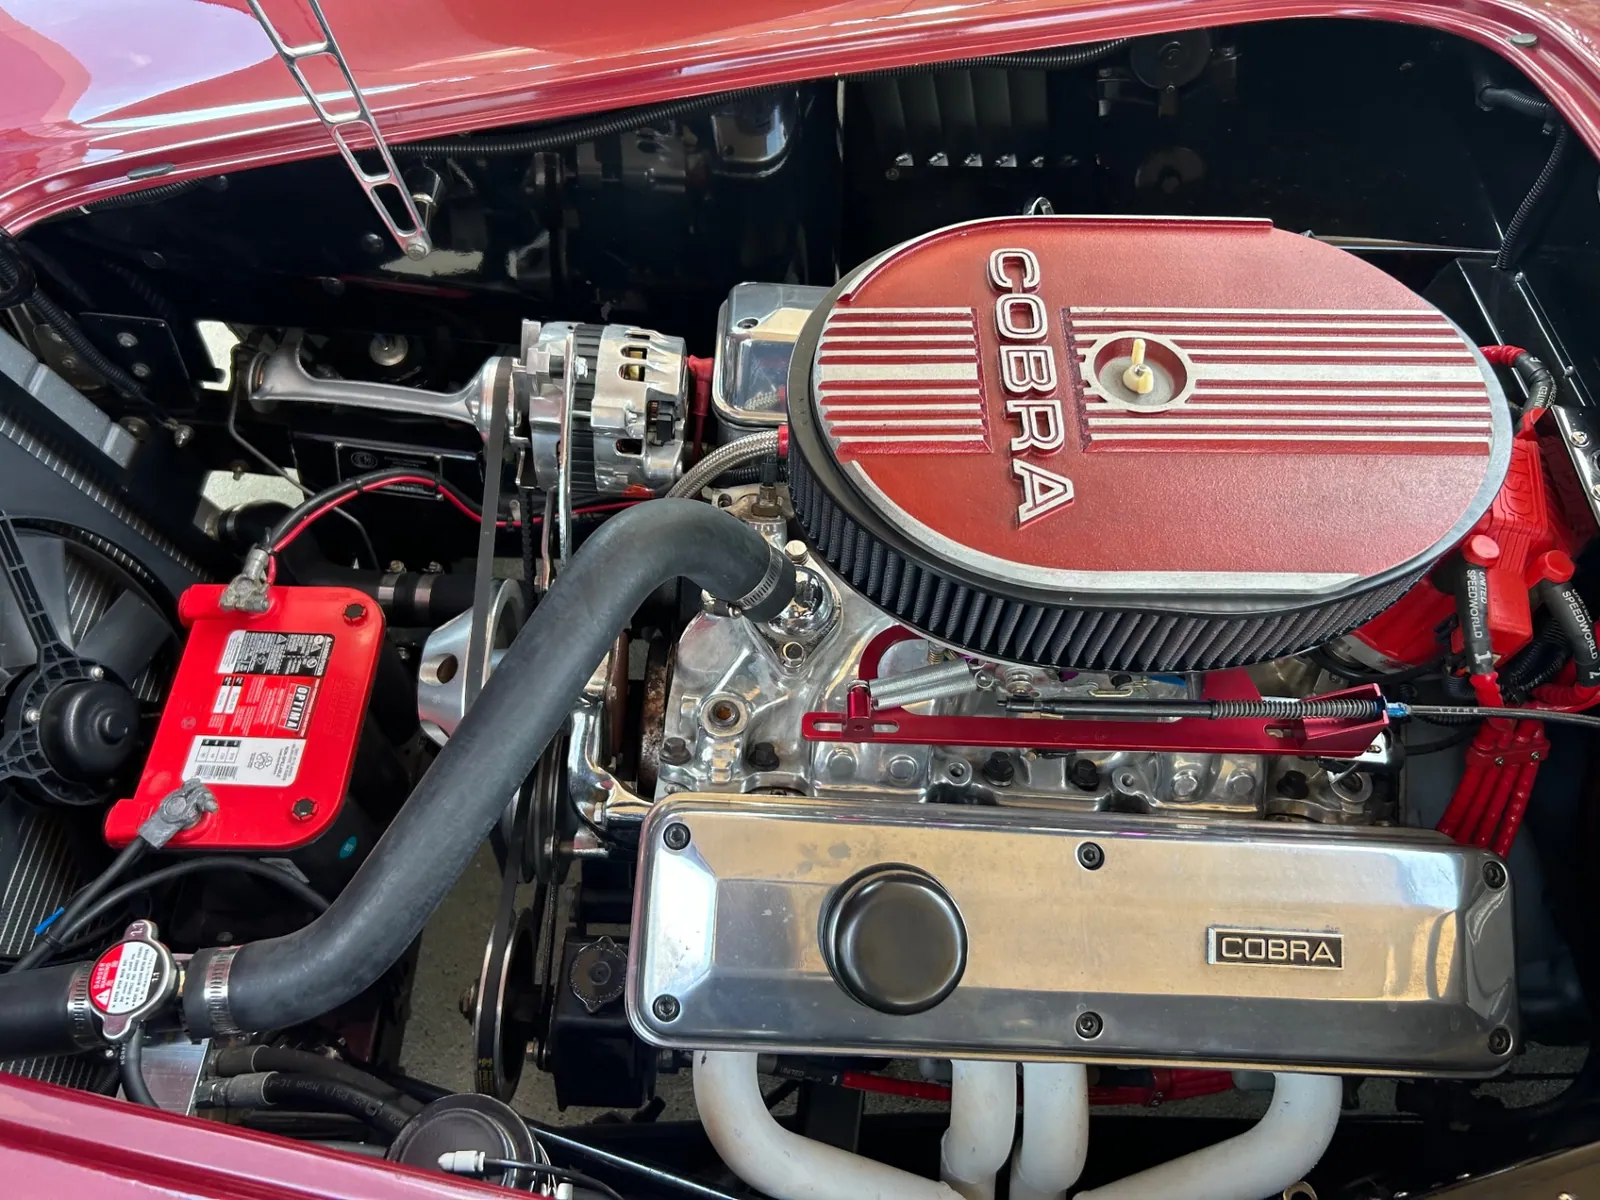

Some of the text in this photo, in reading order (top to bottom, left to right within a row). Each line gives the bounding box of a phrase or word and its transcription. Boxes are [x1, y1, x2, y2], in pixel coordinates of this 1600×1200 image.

[988, 247, 1075, 526] COBRA
[1466, 569, 1483, 639] SPEEDWORLD
[1478, 571, 1488, 604] UNITED
[1562, 590, 1598, 660] SPEEDWORLD
[286, 686, 308, 728] OPTIMA
[1221, 936, 1336, 963] COBRA
